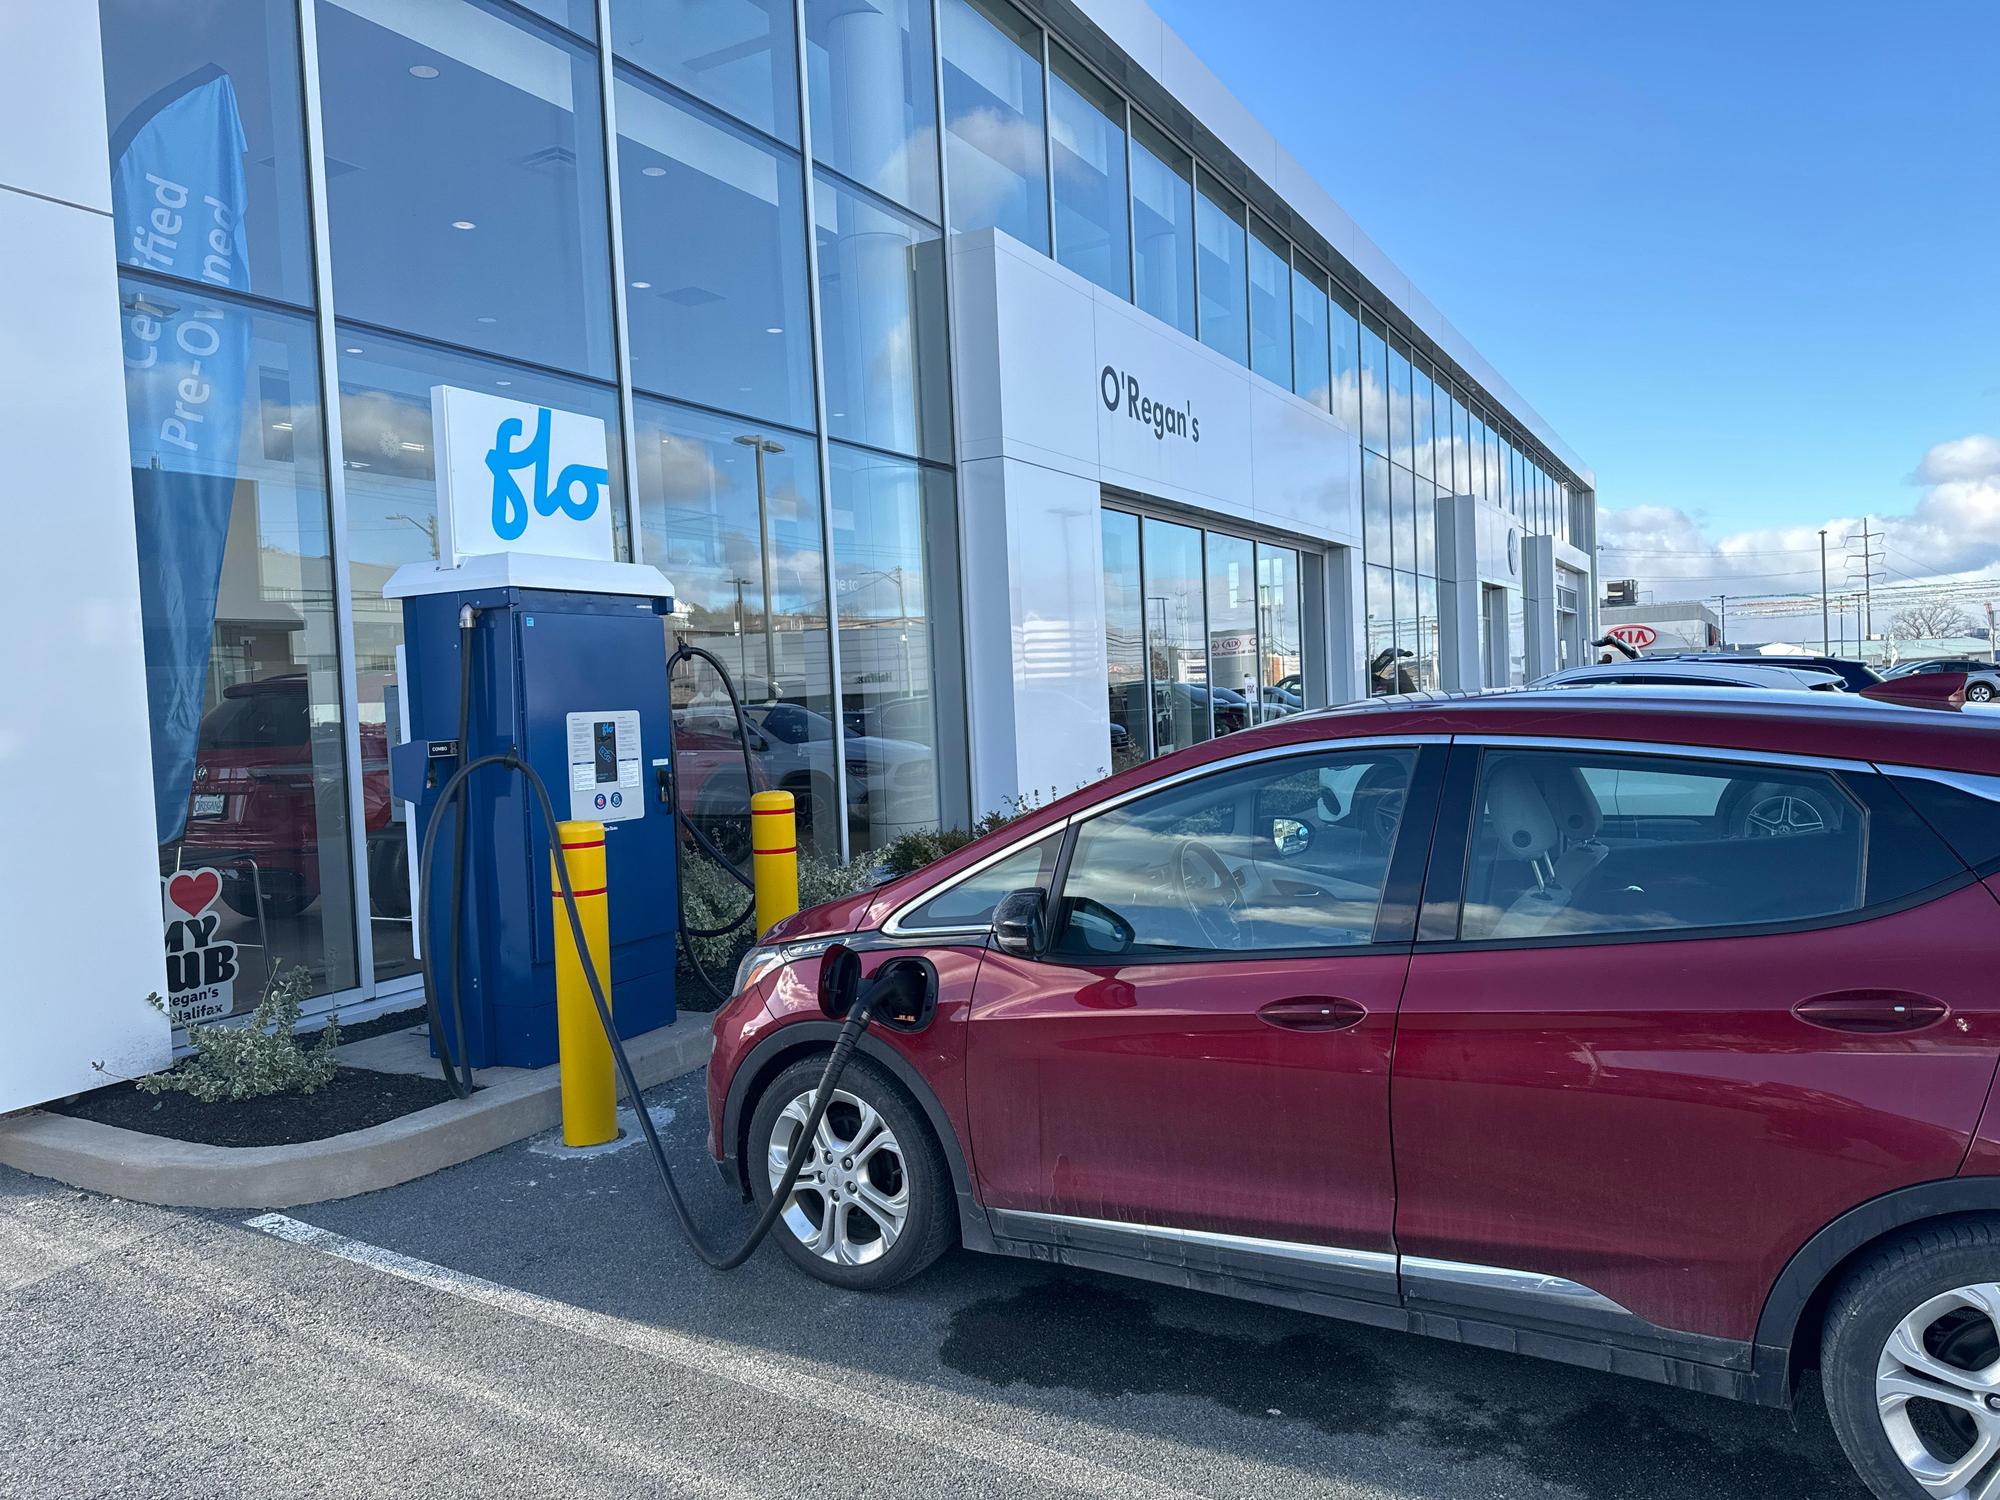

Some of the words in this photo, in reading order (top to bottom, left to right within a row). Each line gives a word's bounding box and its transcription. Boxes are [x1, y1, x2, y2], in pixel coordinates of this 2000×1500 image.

[123, 173, 189, 369] Cefied
[1101, 365, 1200, 443] O'Regan's
[485, 407, 609, 541] flo
[1613, 630, 1648, 644] KIA
[166, 945, 236, 994] UB
